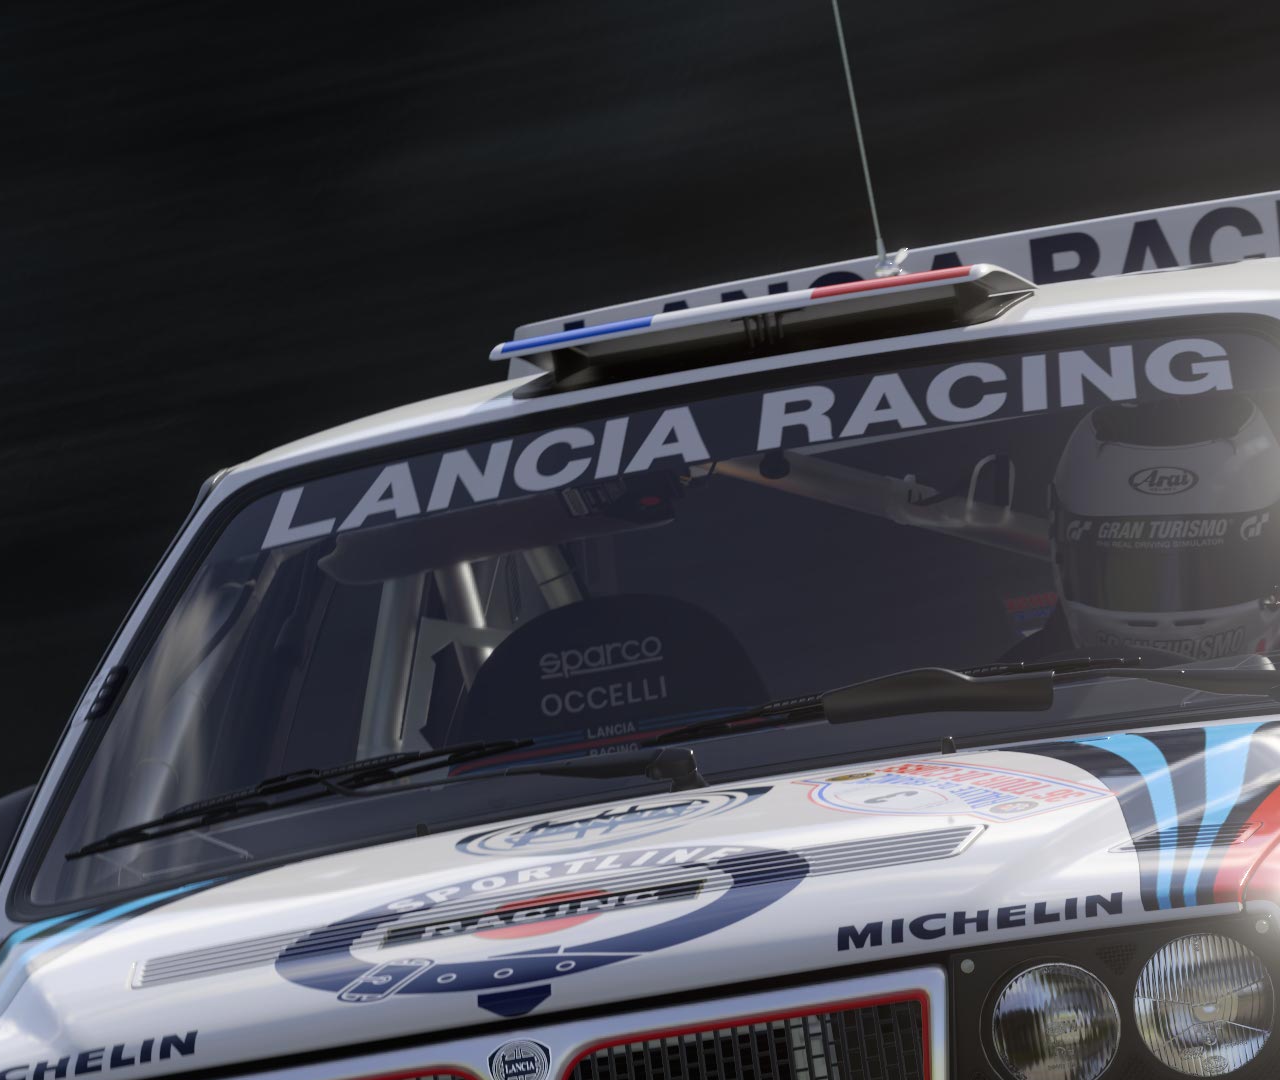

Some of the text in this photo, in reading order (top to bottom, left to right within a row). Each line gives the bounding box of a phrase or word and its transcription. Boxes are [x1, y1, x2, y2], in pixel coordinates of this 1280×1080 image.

[261, 338, 1233, 550] LANCIA RACING
[1132, 468, 1192, 489] Arai
[1098, 518, 1229, 540] GRAN TURISMO
[539, 635, 663, 678] sparco
[540, 676, 668, 717] OCCELLI
[587, 721, 637, 739] LANCIA
[385, 846, 746, 913] SPORTLINE
[422, 890, 662, 939] RACING
[837, 892, 1124, 953] MICHELIN
[505, 1060, 535, 1075] LANCIA
